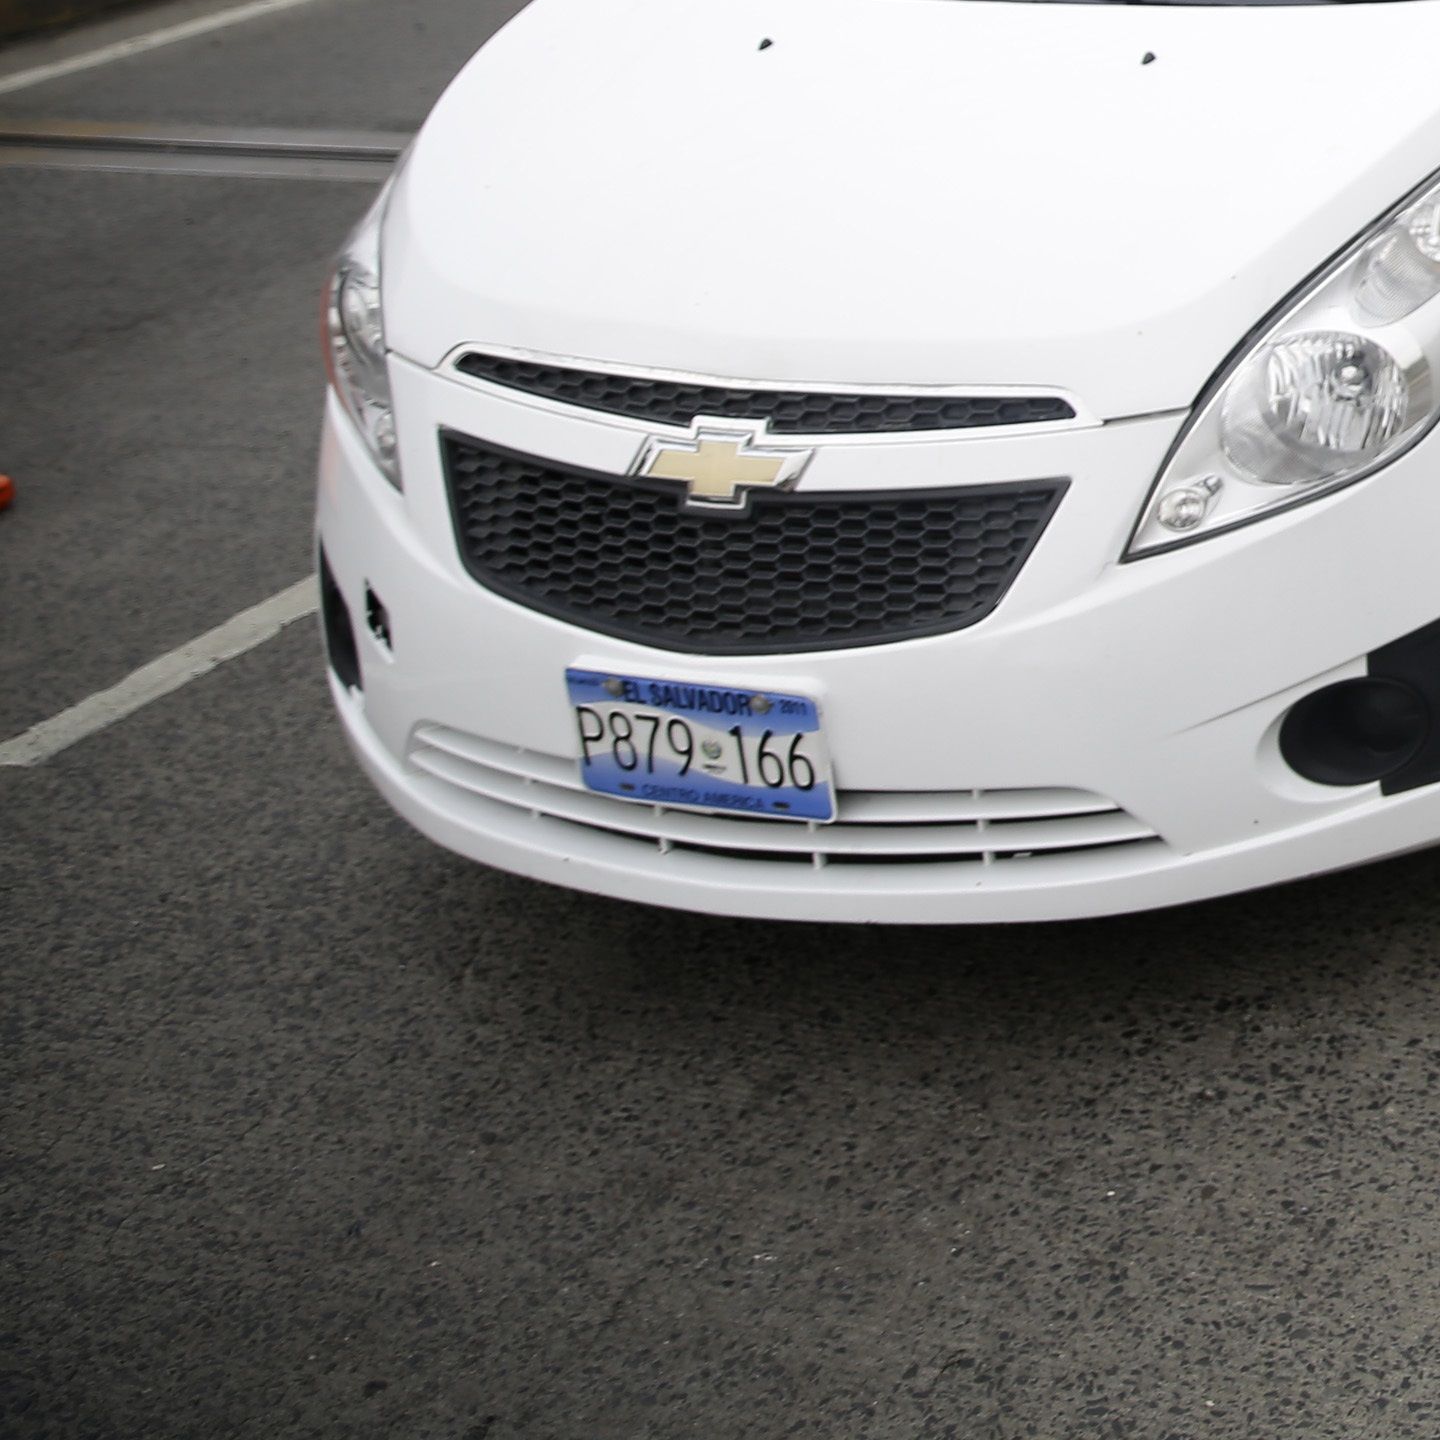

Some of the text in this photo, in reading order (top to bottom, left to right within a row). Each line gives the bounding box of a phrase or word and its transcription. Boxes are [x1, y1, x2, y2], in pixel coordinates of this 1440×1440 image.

[624, 681, 646, 704] EL
[649, 683, 752, 717] SALVADOR
[576, 705, 816, 791] P879 166
[641, 783, 699, 803] CENTRO
